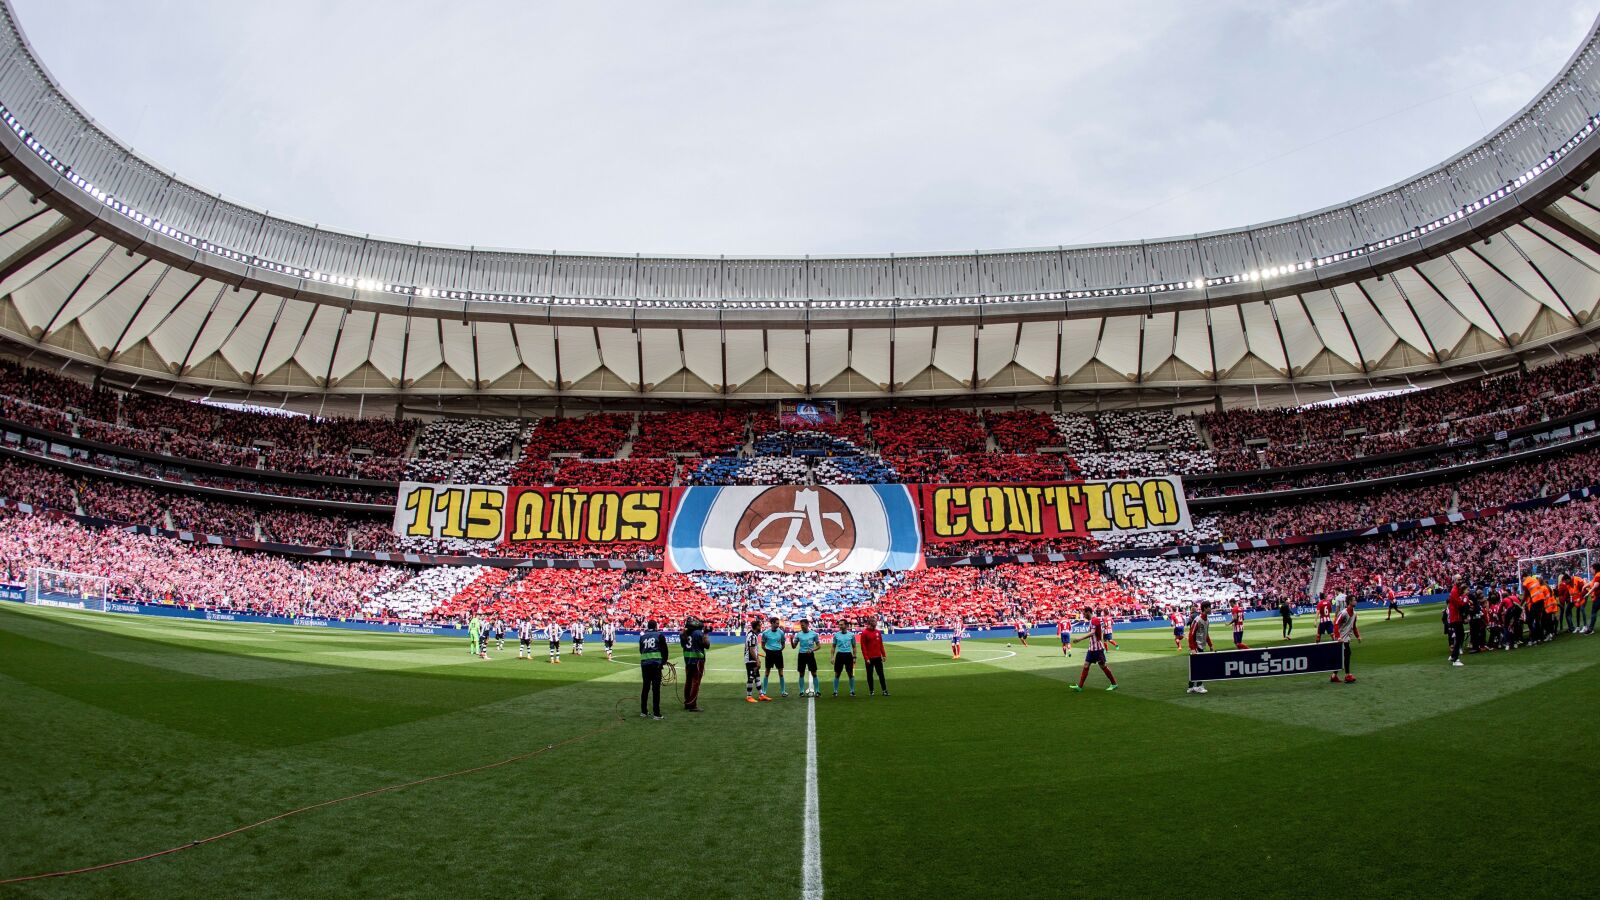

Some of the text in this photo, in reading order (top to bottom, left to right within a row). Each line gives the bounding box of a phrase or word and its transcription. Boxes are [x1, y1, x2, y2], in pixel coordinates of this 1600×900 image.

[405, 487, 661, 542] 115 AÑOS
[934, 479, 1181, 537] CONTIGO
[1323, 605, 1329, 616] 6
[642, 637, 656, 649] 118
[685, 636, 693, 649] 3
[1225, 656, 1308, 676] Plus500
